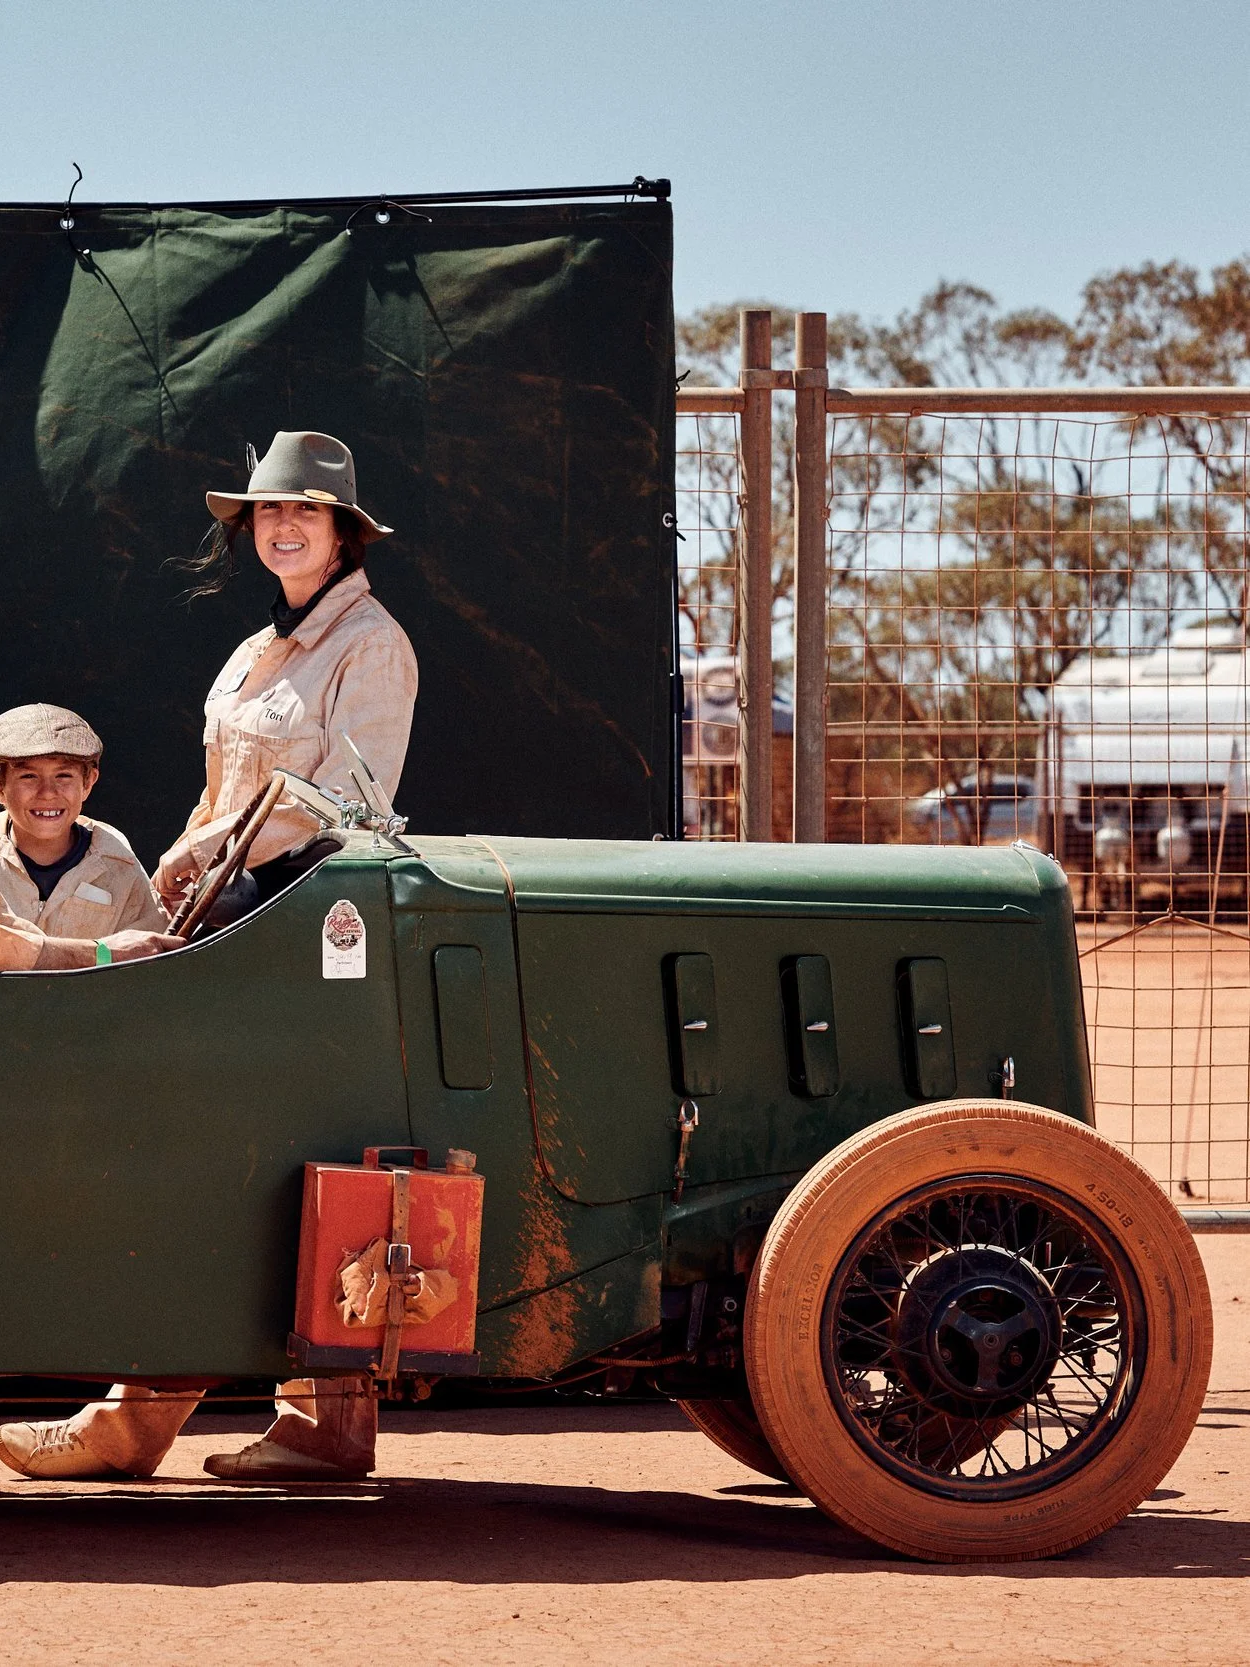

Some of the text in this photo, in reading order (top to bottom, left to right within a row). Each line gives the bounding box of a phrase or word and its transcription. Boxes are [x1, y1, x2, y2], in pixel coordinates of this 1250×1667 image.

[265, 708, 284, 721] Tori
[1085, 1183, 1134, 1228] 4.50-18
[799, 1263, 823, 1340] EXCELSIOR
